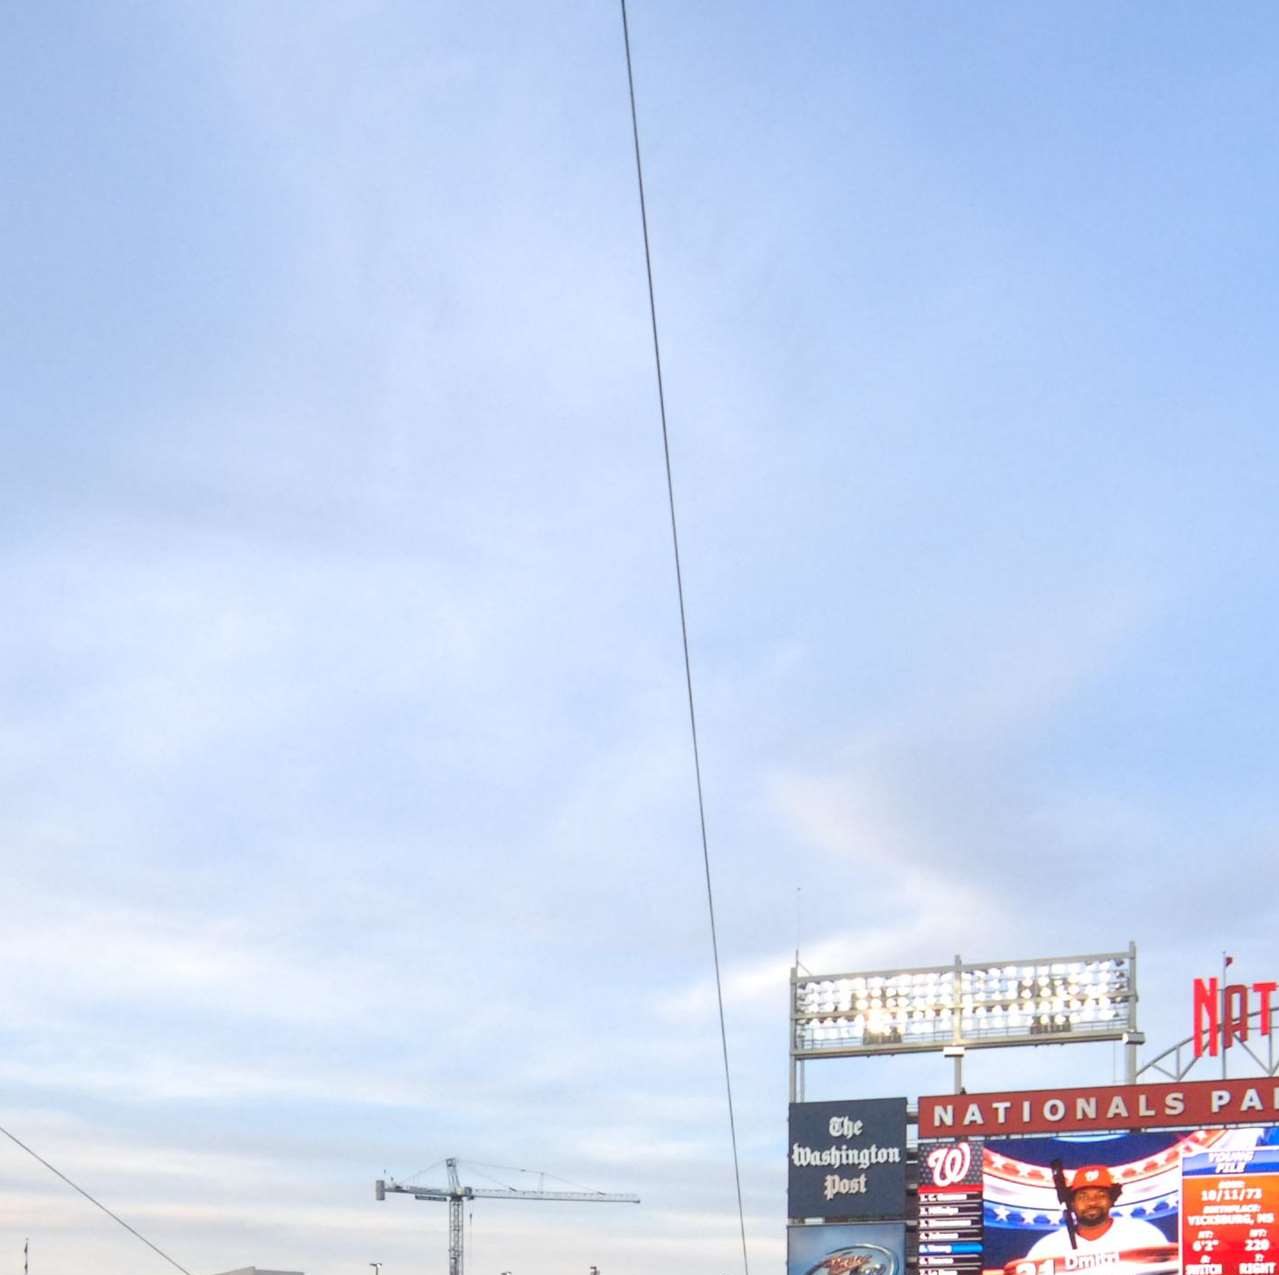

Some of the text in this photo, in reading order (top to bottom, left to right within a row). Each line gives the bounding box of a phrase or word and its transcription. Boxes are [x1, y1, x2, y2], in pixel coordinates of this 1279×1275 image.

[933, 1091, 1185, 1127] NATIONALS
[829, 1116, 863, 1139] The
[792, 1142, 901, 1169] Washington
[928, 1142, 969, 1187] W
[824, 1173, 867, 1200] Post
